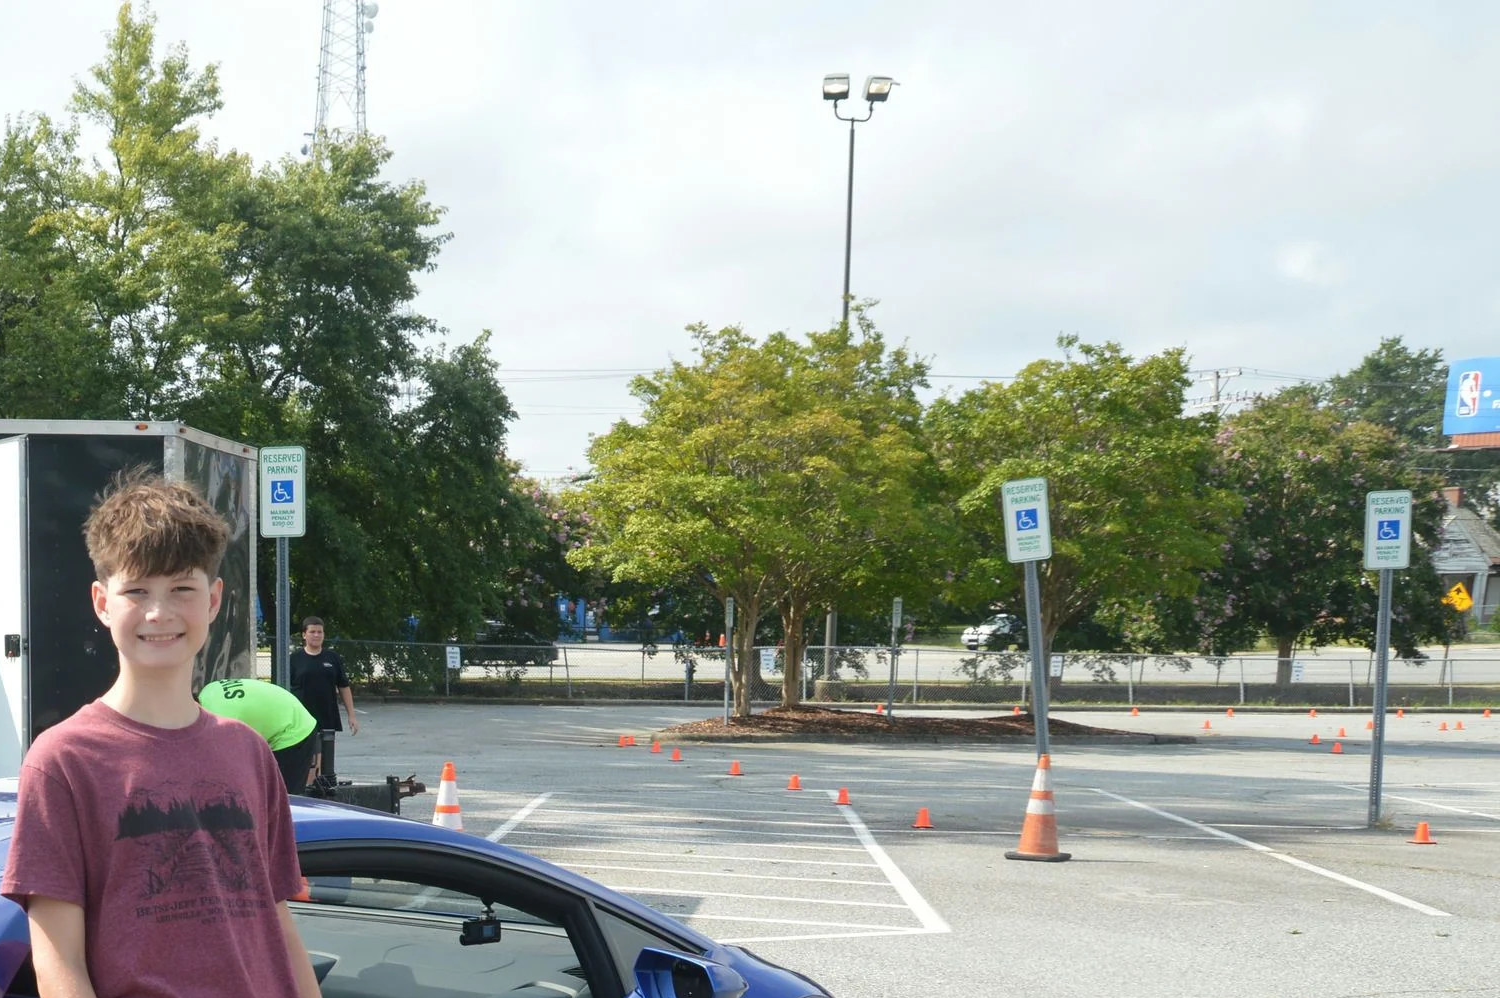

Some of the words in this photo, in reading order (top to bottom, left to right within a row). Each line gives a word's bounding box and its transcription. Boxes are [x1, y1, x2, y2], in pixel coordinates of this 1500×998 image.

[263, 453, 301, 463] RESERVED
[267, 465, 298, 474] PARKING
[1005, 483, 1044, 495] RESERVED
[1010, 494, 1041, 505] PARKING
[1371, 496, 1409, 505] RESERVED
[1374, 506, 1405, 515] PARKING
